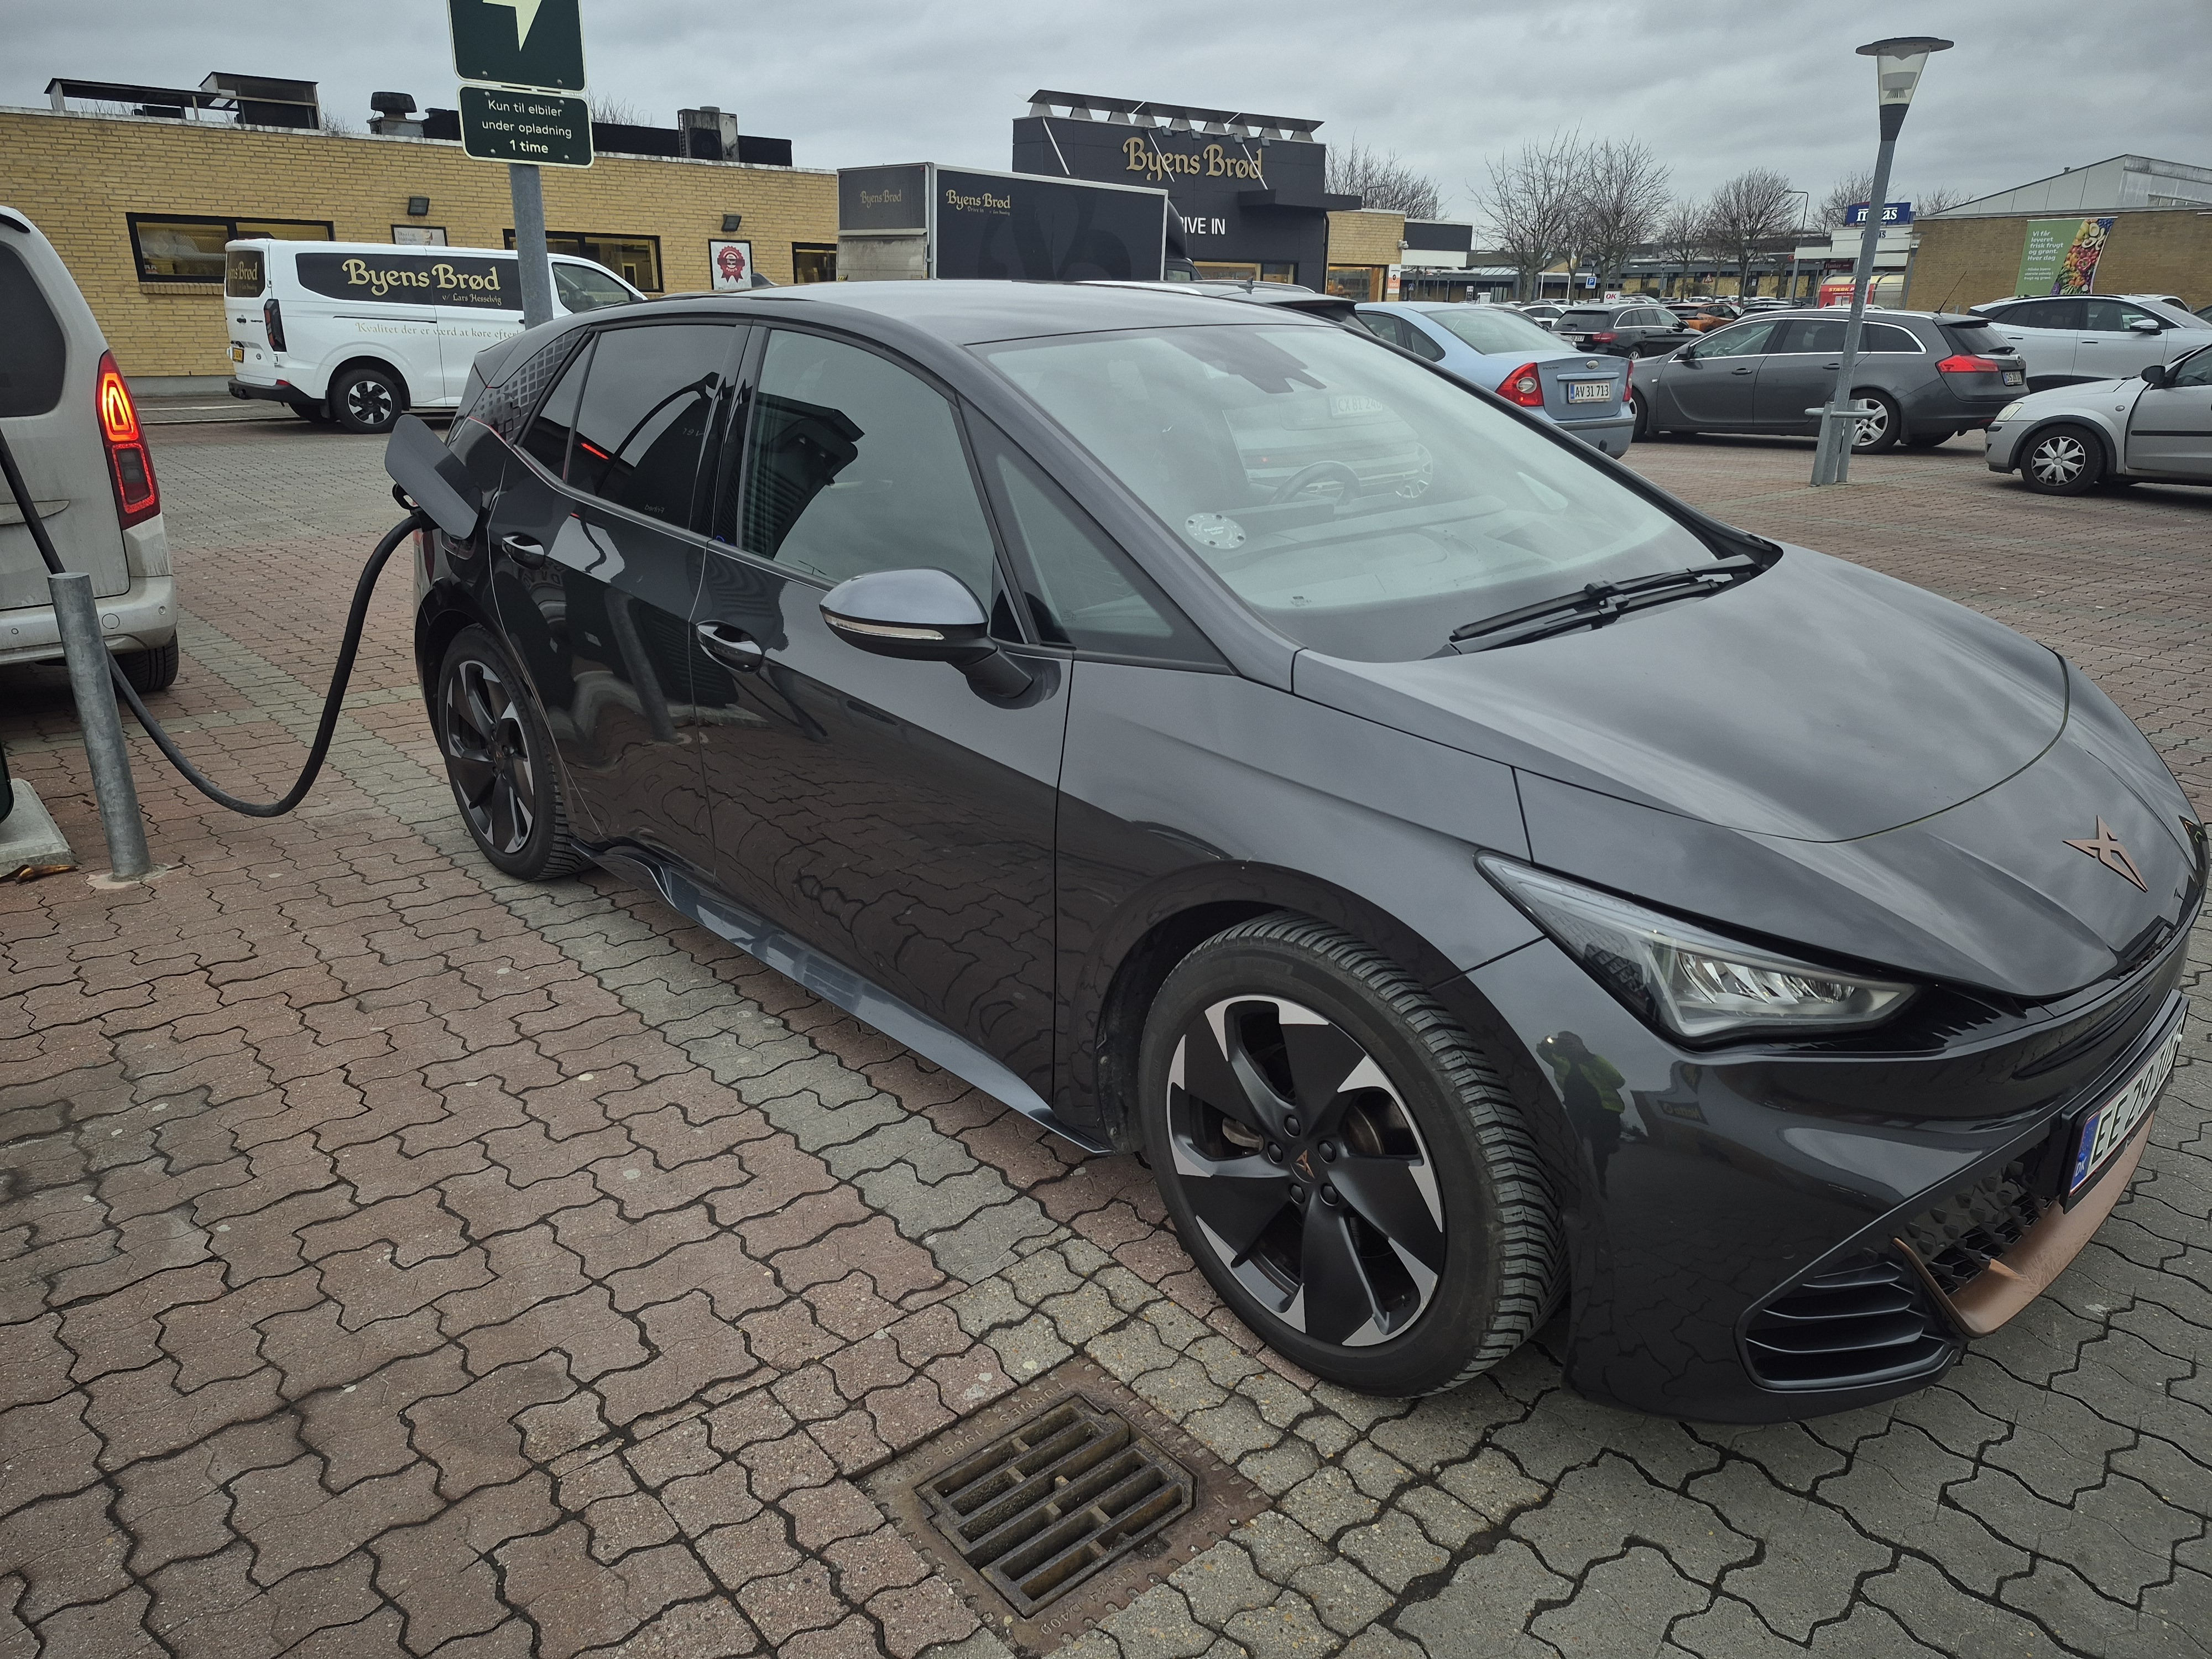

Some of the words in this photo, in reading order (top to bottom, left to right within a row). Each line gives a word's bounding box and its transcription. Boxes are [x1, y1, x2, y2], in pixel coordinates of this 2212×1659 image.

[488, 100, 510, 111] Kun
[513, 103, 525, 113] til
[529, 105, 562, 117] elbiler
[482, 121, 515, 131] under
[519, 124, 572, 139] opladning
[509, 140, 516, 151] 1
[519, 141, 549, 154] time
[1123, 137, 1201, 181] Byens
[1203, 144, 1263, 179] Brød
[860, 190, 882, 208] Byens
[883, 190, 901, 204] Brød
[946, 189, 981, 210] Byens
[982, 193, 1011, 208] Brød
[1856, 207, 1898, 221] mas
[1180, 217, 1206, 234] IVE
[1212, 218, 1225, 235] IN
[238, 261, 258, 280] Brød
[342, 259, 430, 296] Byens
[431, 264, 500, 291] Brød
[453, 293, 468, 302] Lars
[470, 294, 502, 306] Hesselvig
[355, 322, 397, 335] Kvalitet
[401, 325, 417, 334] der
[433, 327, 457, 336] værd
[472, 328, 491, 337] køre
[1575, 386, 1585, 397] AV
[1587, 386, 1594, 397] 31
[1597, 385, 1609, 397] 713
[2091, 1093, 2128, 1166] EE
[2125, 1064, 2154, 1131] 29
[2075, 1159, 2086, 1176] DK
[999, 1382, 1066, 1424] FURNES
[1088, 1567, 1138, 1602] EN124
[1040, 1603, 1083, 1635] D400
